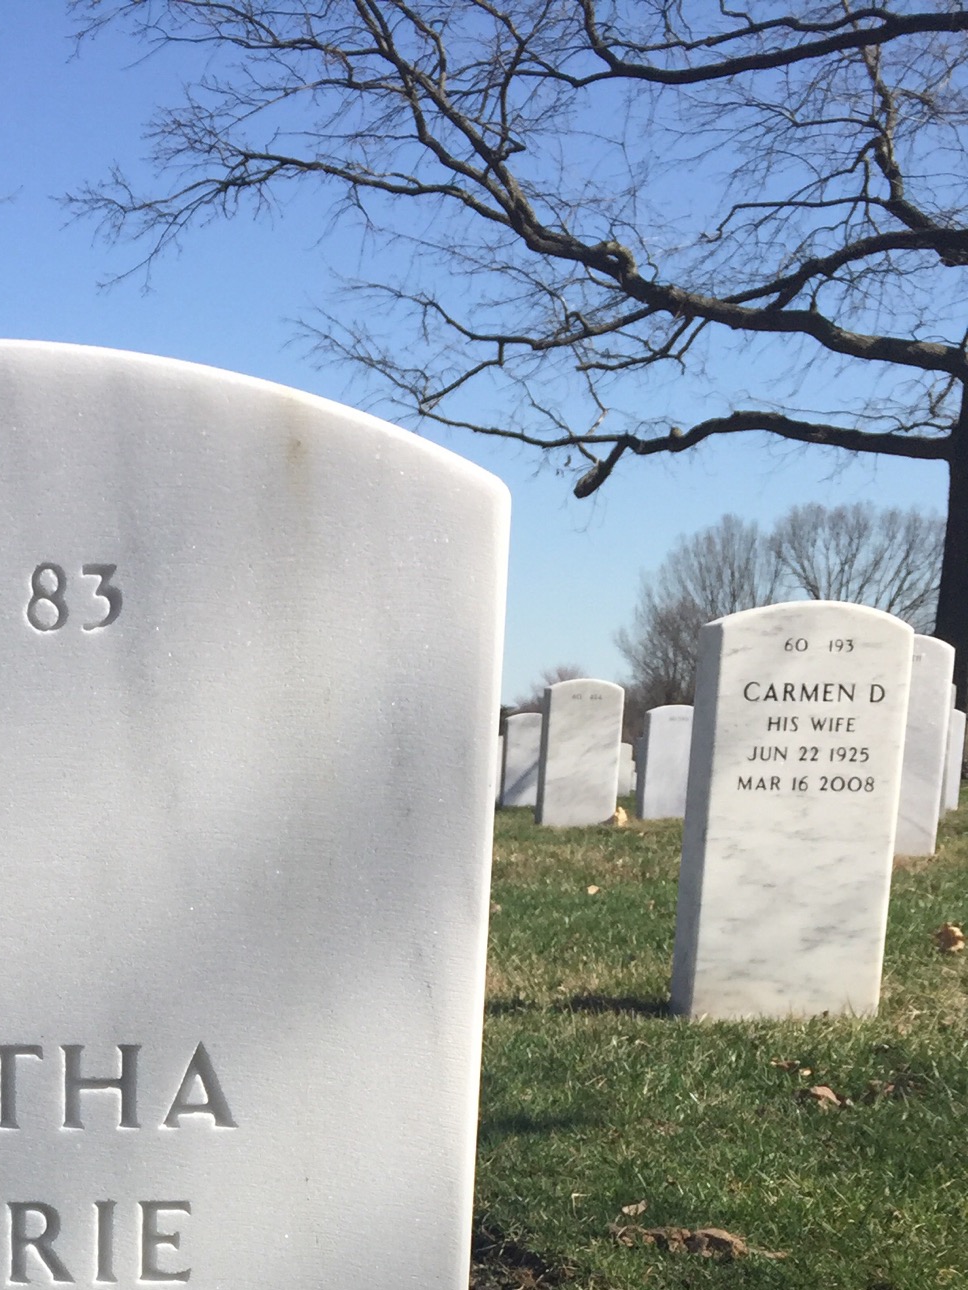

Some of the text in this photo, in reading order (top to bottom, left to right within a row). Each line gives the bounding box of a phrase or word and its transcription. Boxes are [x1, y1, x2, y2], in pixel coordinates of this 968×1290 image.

[27, 562, 123, 631] 83
[784, 638, 854, 653] 60 193
[743, 681, 886, 703] CARMEN D
[767, 716, 856, 732] HIS WIFE
[747, 746, 870, 763] JUN 22 1925
[737, 776, 875, 793] MAR 16 2008
